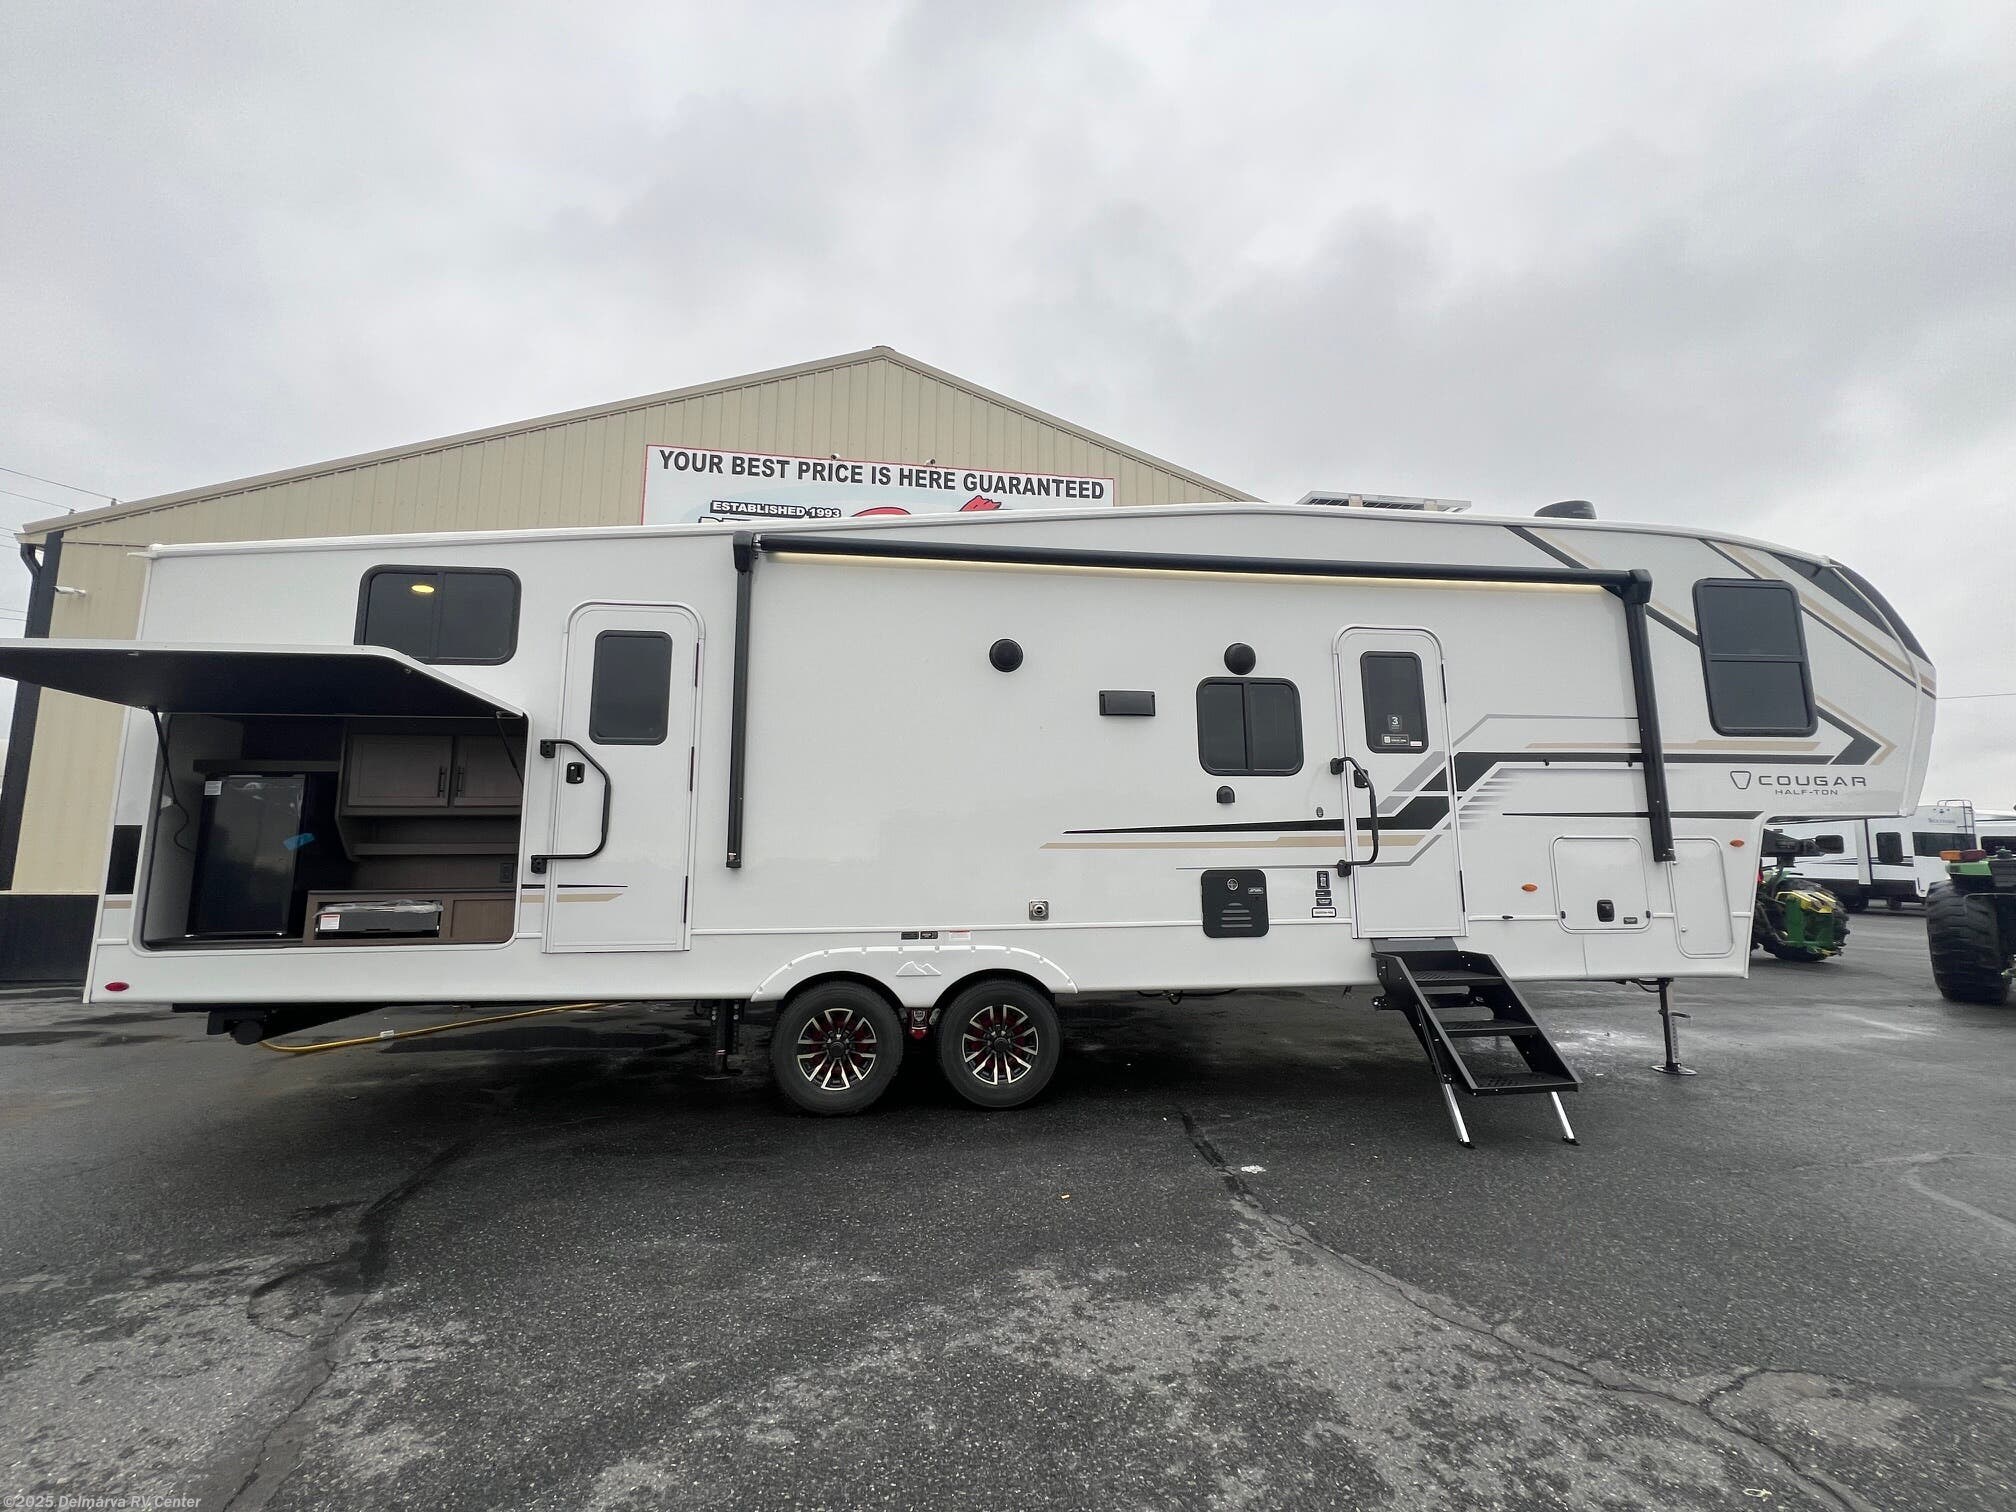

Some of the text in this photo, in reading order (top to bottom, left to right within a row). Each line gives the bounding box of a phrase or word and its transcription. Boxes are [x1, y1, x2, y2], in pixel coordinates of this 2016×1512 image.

[659, 449, 1104, 500] YOUR BEST PRICE IS HERE GUARANTEED
[711, 501, 841, 519] ESTABLISHED 1993
[1391, 716, 1399, 725] 3
[1758, 775, 1867, 787] COUGAR
